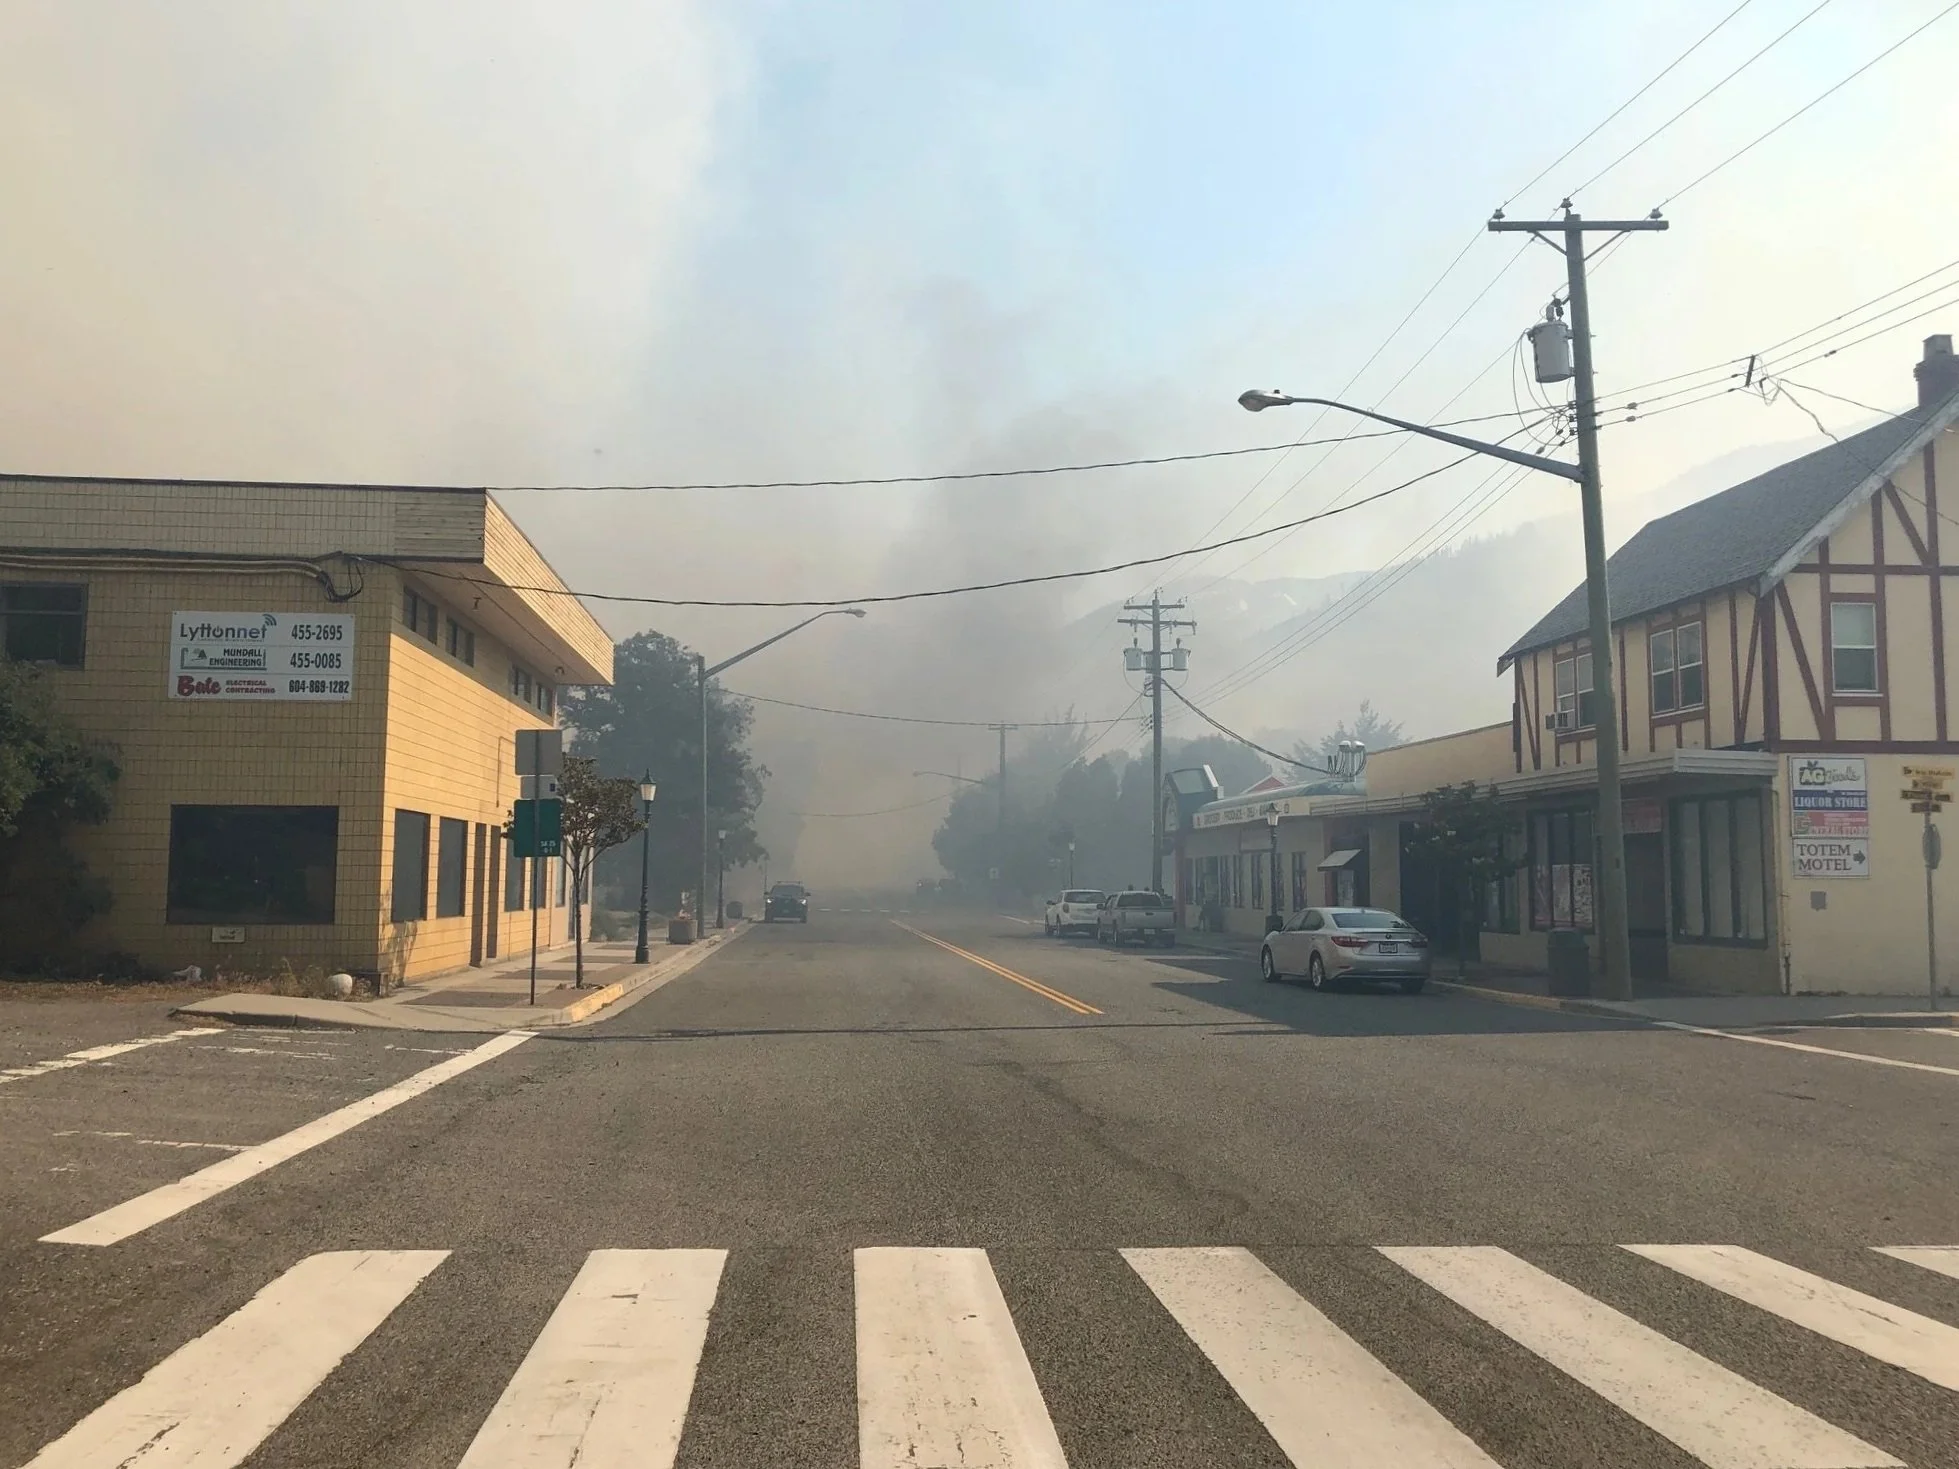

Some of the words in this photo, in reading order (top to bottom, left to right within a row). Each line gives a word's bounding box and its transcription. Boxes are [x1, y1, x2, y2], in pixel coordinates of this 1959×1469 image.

[179, 622, 267, 641] Lyttonnet
[291, 624, 343, 641] 455-2695
[223, 648, 263, 657] MUNDALL
[209, 657, 262, 667] ENGINEERING
[290, 652, 342, 669] 455-0085
[225, 686, 276, 694] CONTRACTING
[1800, 768, 1825, 785] AG
[1794, 796, 1832, 808] LIQUOR
[1834, 796, 1867, 808] STORE
[1796, 843, 1851, 857] TOTEM
[1798, 858, 1852, 871] MOTEL
